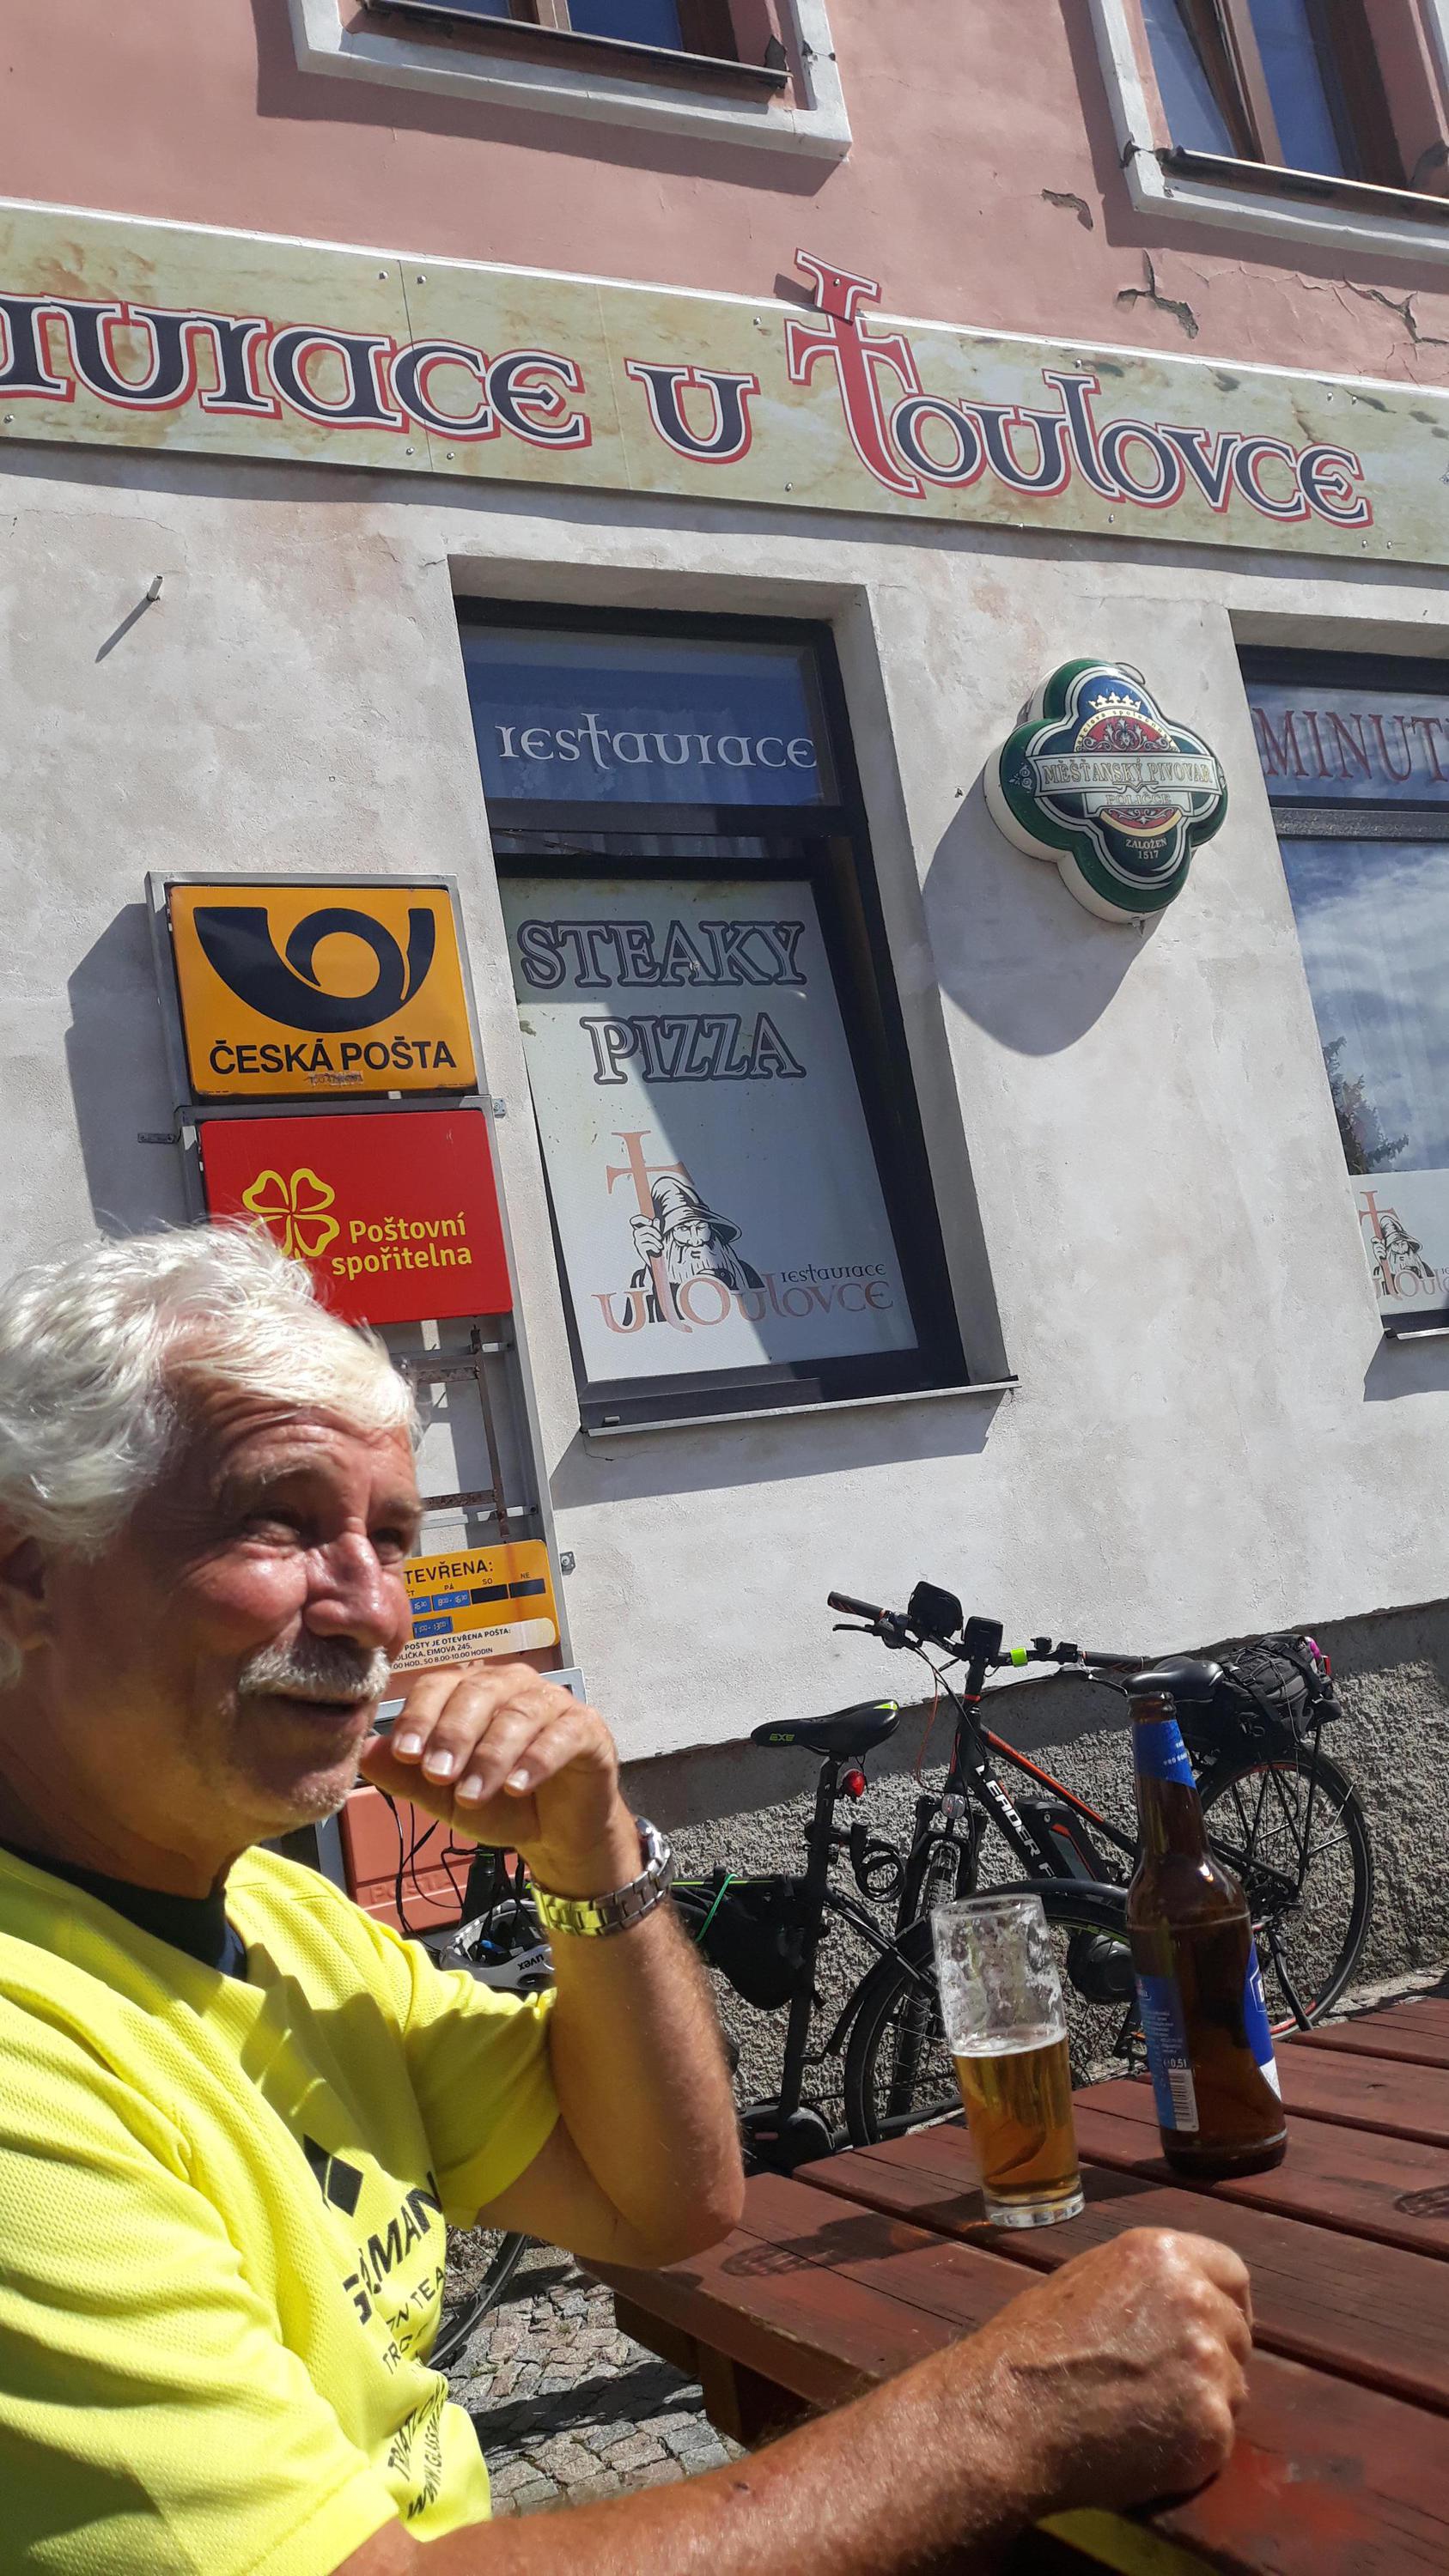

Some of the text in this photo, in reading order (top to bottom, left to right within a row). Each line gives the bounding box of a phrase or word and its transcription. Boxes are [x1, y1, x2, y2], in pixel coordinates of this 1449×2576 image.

[494, 712, 818, 770] restaurace
[1251, 708, 1449, 782] MINUT
[1148, 761, 1214, 784] PIVOVAR
[1125, 837, 1167, 849] ZALOŽEN
[1139, 849, 1160, 860] 1517
[517, 920, 807, 989] STEAKY
[209, 1036, 457, 1074] ČESKÁ POŠTA
[580, 1012, 807, 1085] PIZZA
[349, 1211, 466, 1244] Poštovní
[332, 1242, 473, 1281] spořitelna
[781, 1262, 887, 1285] restaurace
[404, 1559, 494, 1585] TEVŘENA:
[482, 1577, 493, 1586] SO
[521, 1571, 531, 1580] NE
[405, 1640, 430, 1651] POŠTY
[441, 1631, 483, 1645] OTEVŘENA
[484, 1627, 511, 1638] POŠTA:
[395, 1649, 426, 1662] OLIČKA,
[471, 1647, 493, 1657] HODIN
[769, 1733, 795, 1742] EXE
[975, 1765, 1041, 1857] LEADER
[517, 1953, 545, 1971] uvex
